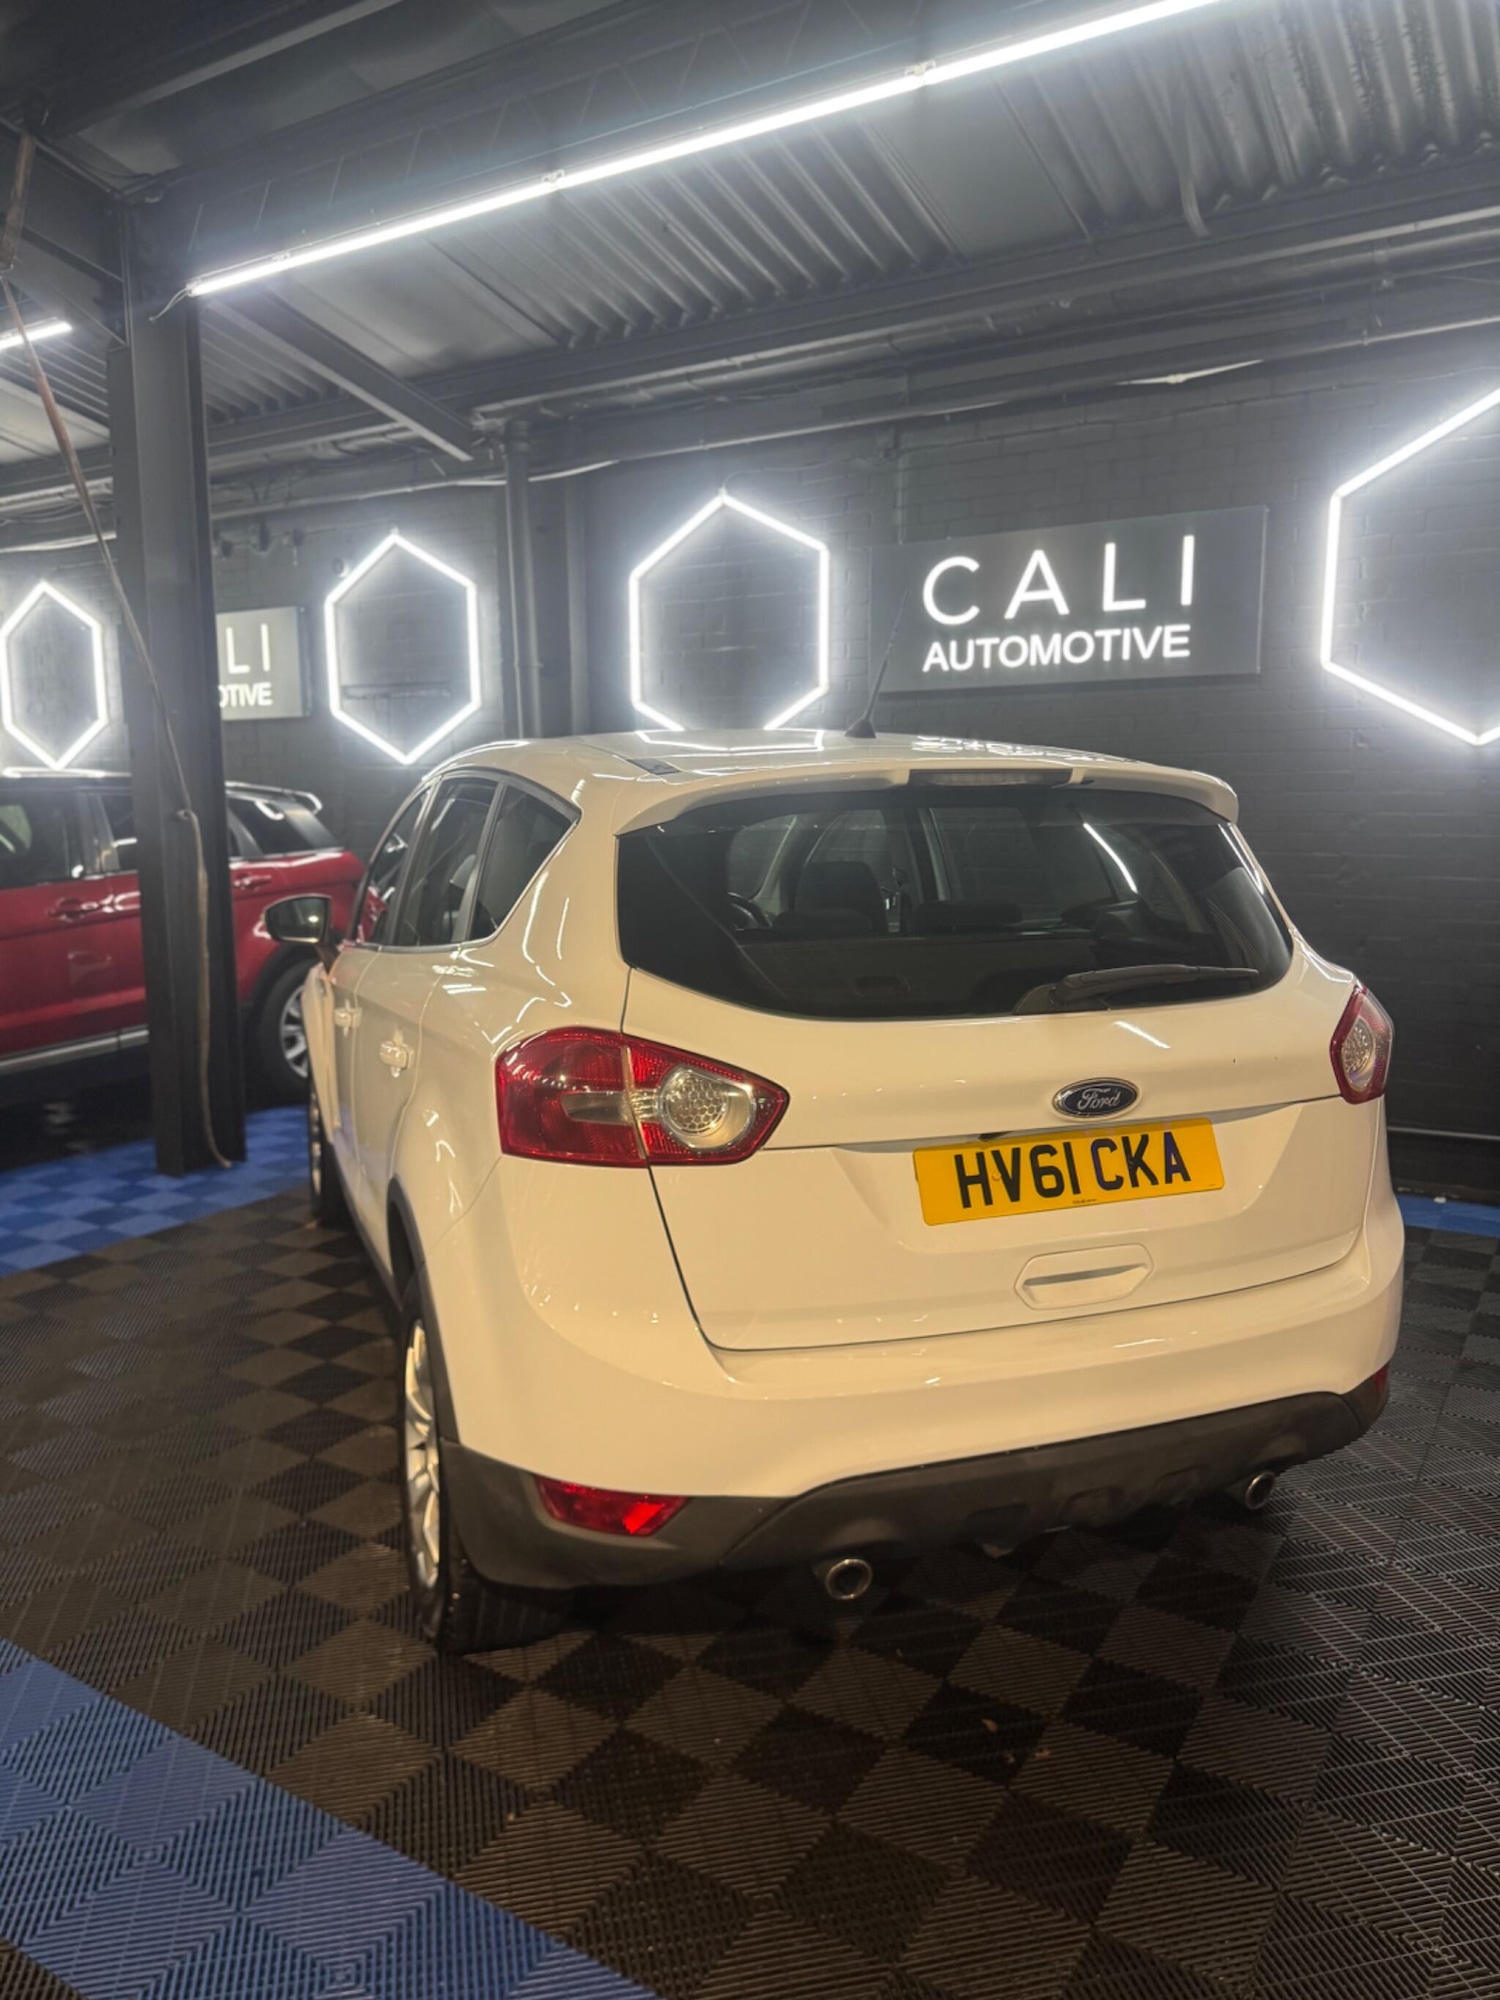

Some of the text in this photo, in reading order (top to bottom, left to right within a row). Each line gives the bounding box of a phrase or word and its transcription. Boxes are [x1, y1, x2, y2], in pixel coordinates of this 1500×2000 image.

[922, 534, 1195, 626] CALI
[921, 623, 1191, 673] AUTOMOTIVE
[1077, 1087, 1122, 1110] Ford
[953, 1131, 1192, 1209] HV61 CKA
